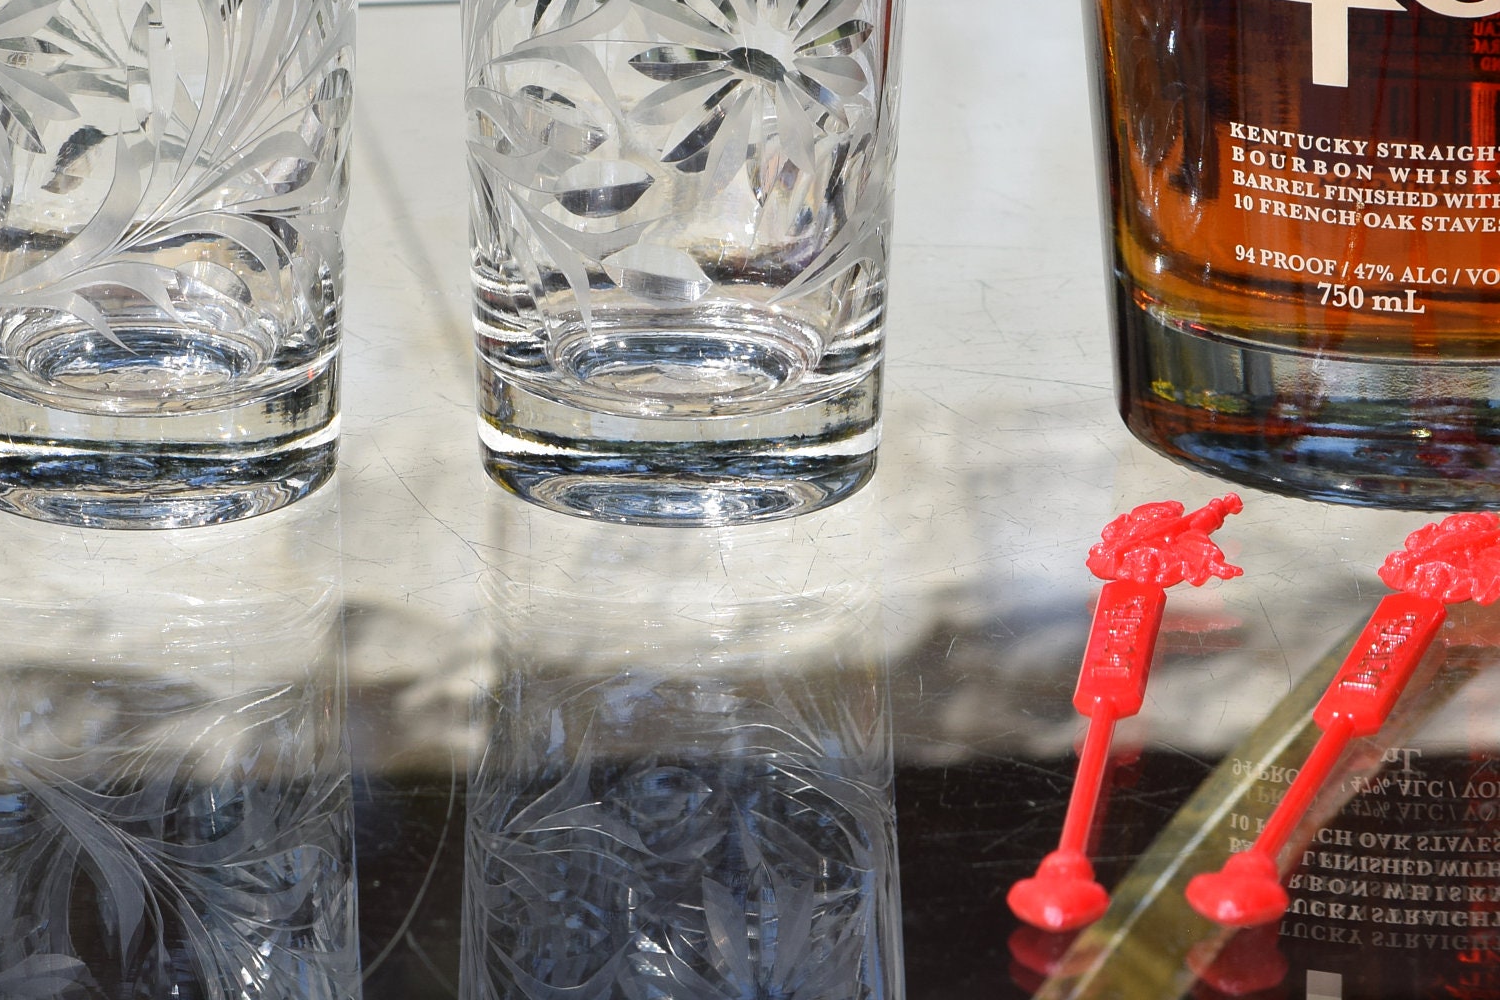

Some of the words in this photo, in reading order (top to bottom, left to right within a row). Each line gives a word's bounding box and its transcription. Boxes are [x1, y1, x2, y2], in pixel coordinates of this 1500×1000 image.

[1229, 121, 1369, 156] KENTUCKY
[1231, 145, 1374, 181] BOURBON
[1388, 166, 1500, 185] WHISK
[1232, 169, 1320, 199] BARREL
[1324, 184, 1438, 208] FINISHED
[1234, 193, 1254, 211] 10
[1259, 197, 1357, 226] FRENCH
[1363, 212, 1416, 231] OAK
[1421, 216, 1500, 232] STAVE
[1235, 244, 1256, 264] 94
[1259, 248, 1337, 276] PROOF
[1341, 261, 1349, 278] /
[1353, 263, 1394, 282] 47%
[1399, 266, 1447, 285] ALC
[1452, 268, 1461, 285] /
[1317, 281, 1364, 309] 750
[1371, 289, 1425, 314] mL
